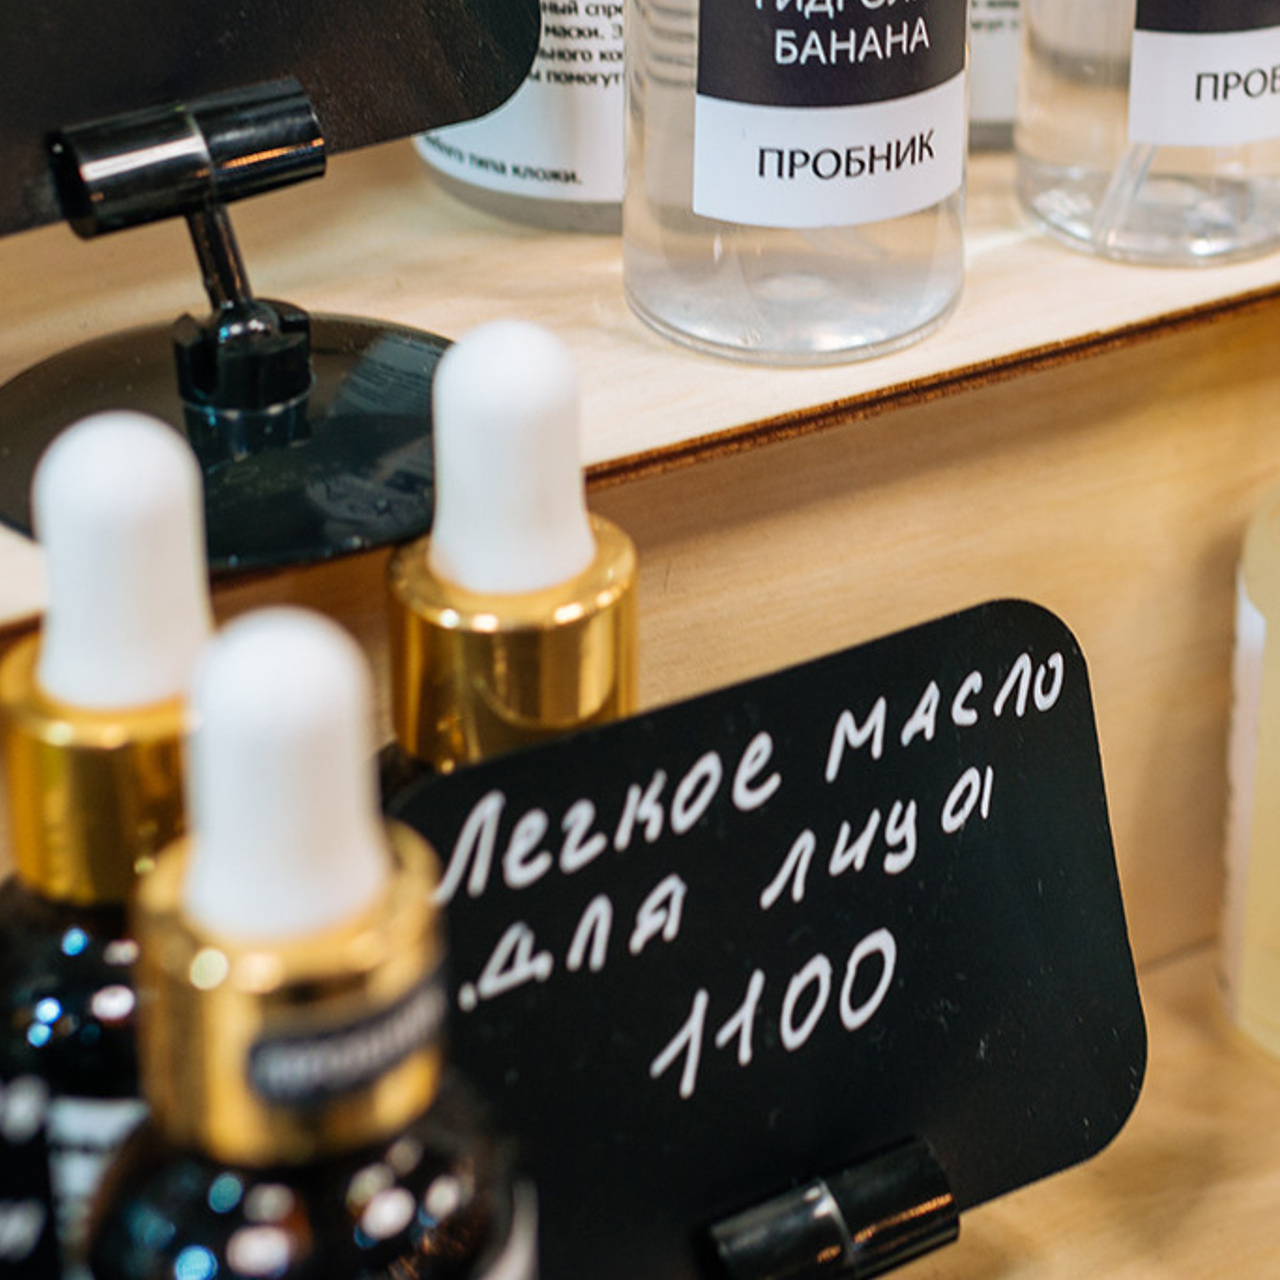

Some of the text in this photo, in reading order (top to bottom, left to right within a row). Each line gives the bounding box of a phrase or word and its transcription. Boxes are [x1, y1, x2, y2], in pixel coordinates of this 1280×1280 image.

[774, 17, 930, 66] БАНАНА
[757, 129, 936, 181] ПРОБНИК
[650, 926, 898, 1099] 1100
